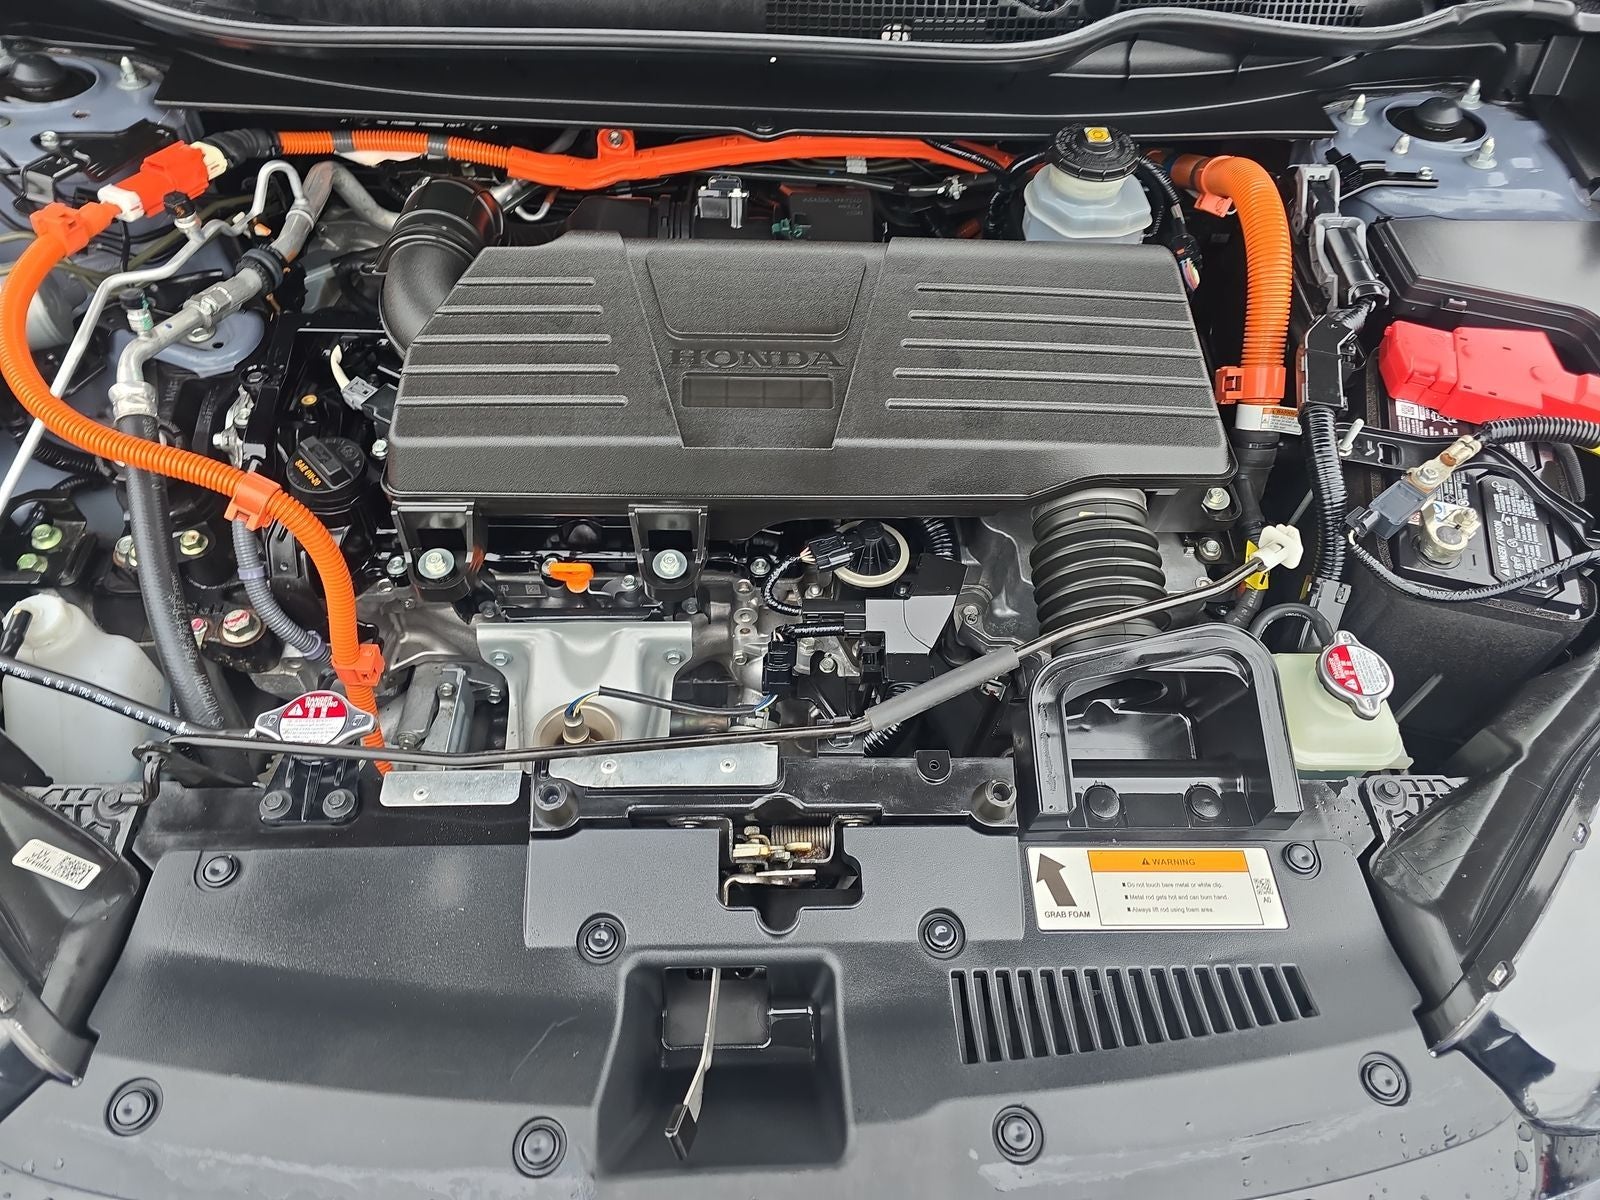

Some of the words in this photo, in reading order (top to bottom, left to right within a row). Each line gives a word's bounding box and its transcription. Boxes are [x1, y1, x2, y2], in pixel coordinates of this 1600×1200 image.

[669, 349, 845, 370] HONDA
[294, 459, 309, 473] SAE
[1152, 858, 1196, 866] WARNING
[1044, 911, 1067, 919] GRAB
[1068, 911, 1091, 919] FOAM
